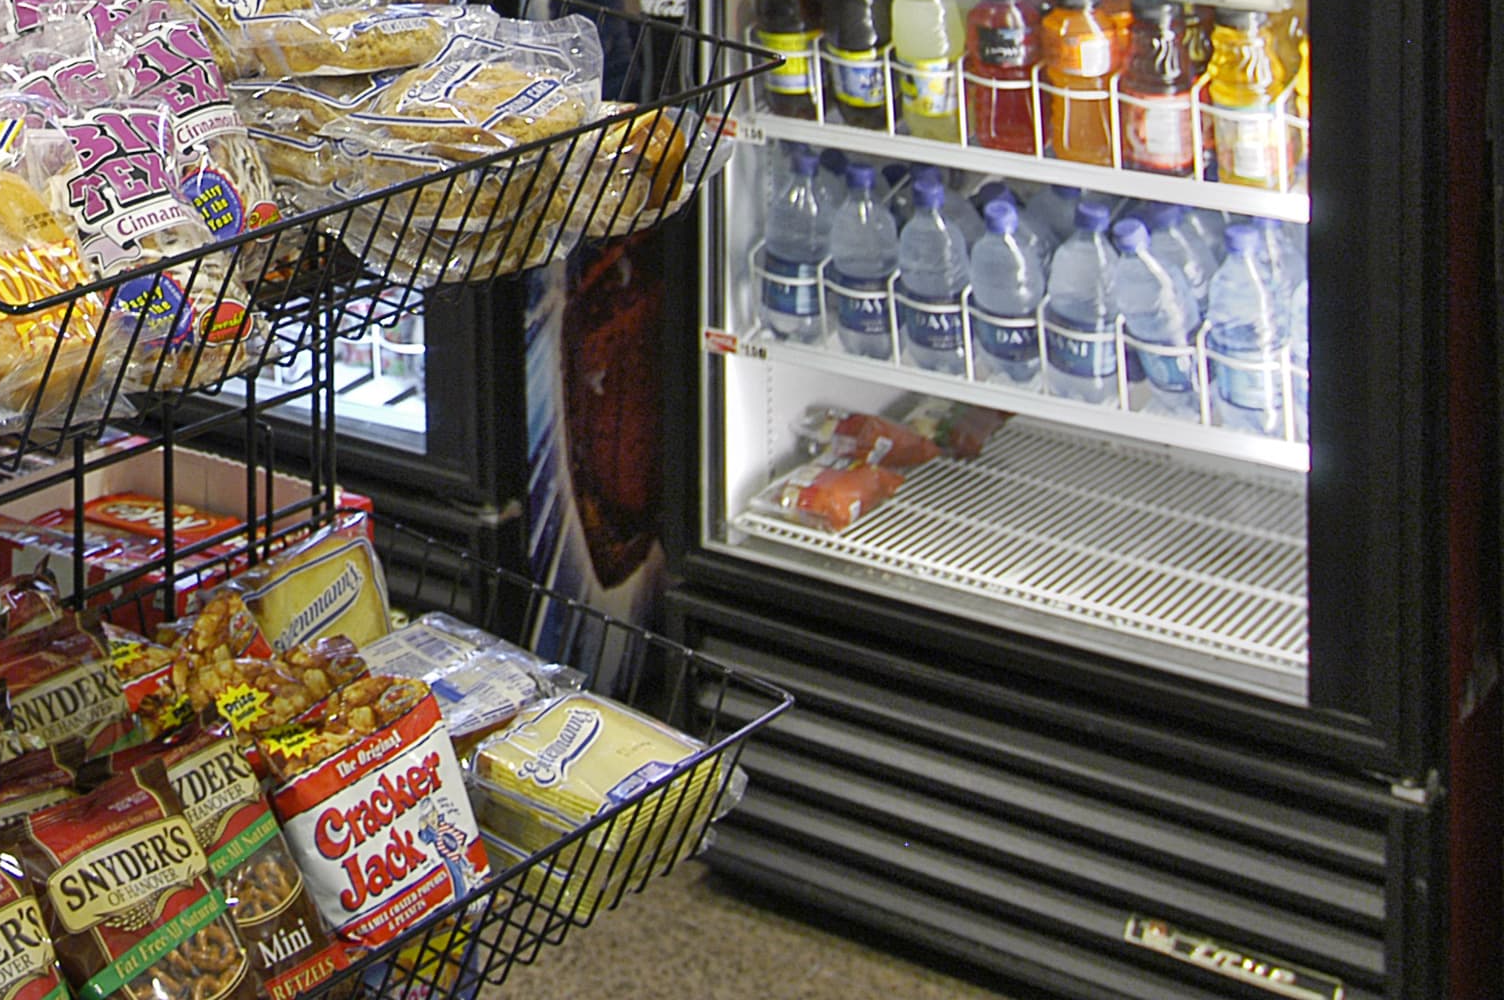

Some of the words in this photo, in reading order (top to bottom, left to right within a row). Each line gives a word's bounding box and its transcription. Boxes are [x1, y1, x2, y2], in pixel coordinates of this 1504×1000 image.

[224, 690, 258, 713] Prize
[335, 760, 357, 779] The
[357, 729, 403, 763] Original
[314, 751, 443, 861] Cracker
[58, 825, 192, 913] SNYDER'S
[126, 868, 178, 902] HANOVER
[340, 826, 428, 912] Jack
[113, 953, 139, 981] Fat
[258, 918, 314, 969] Mini
